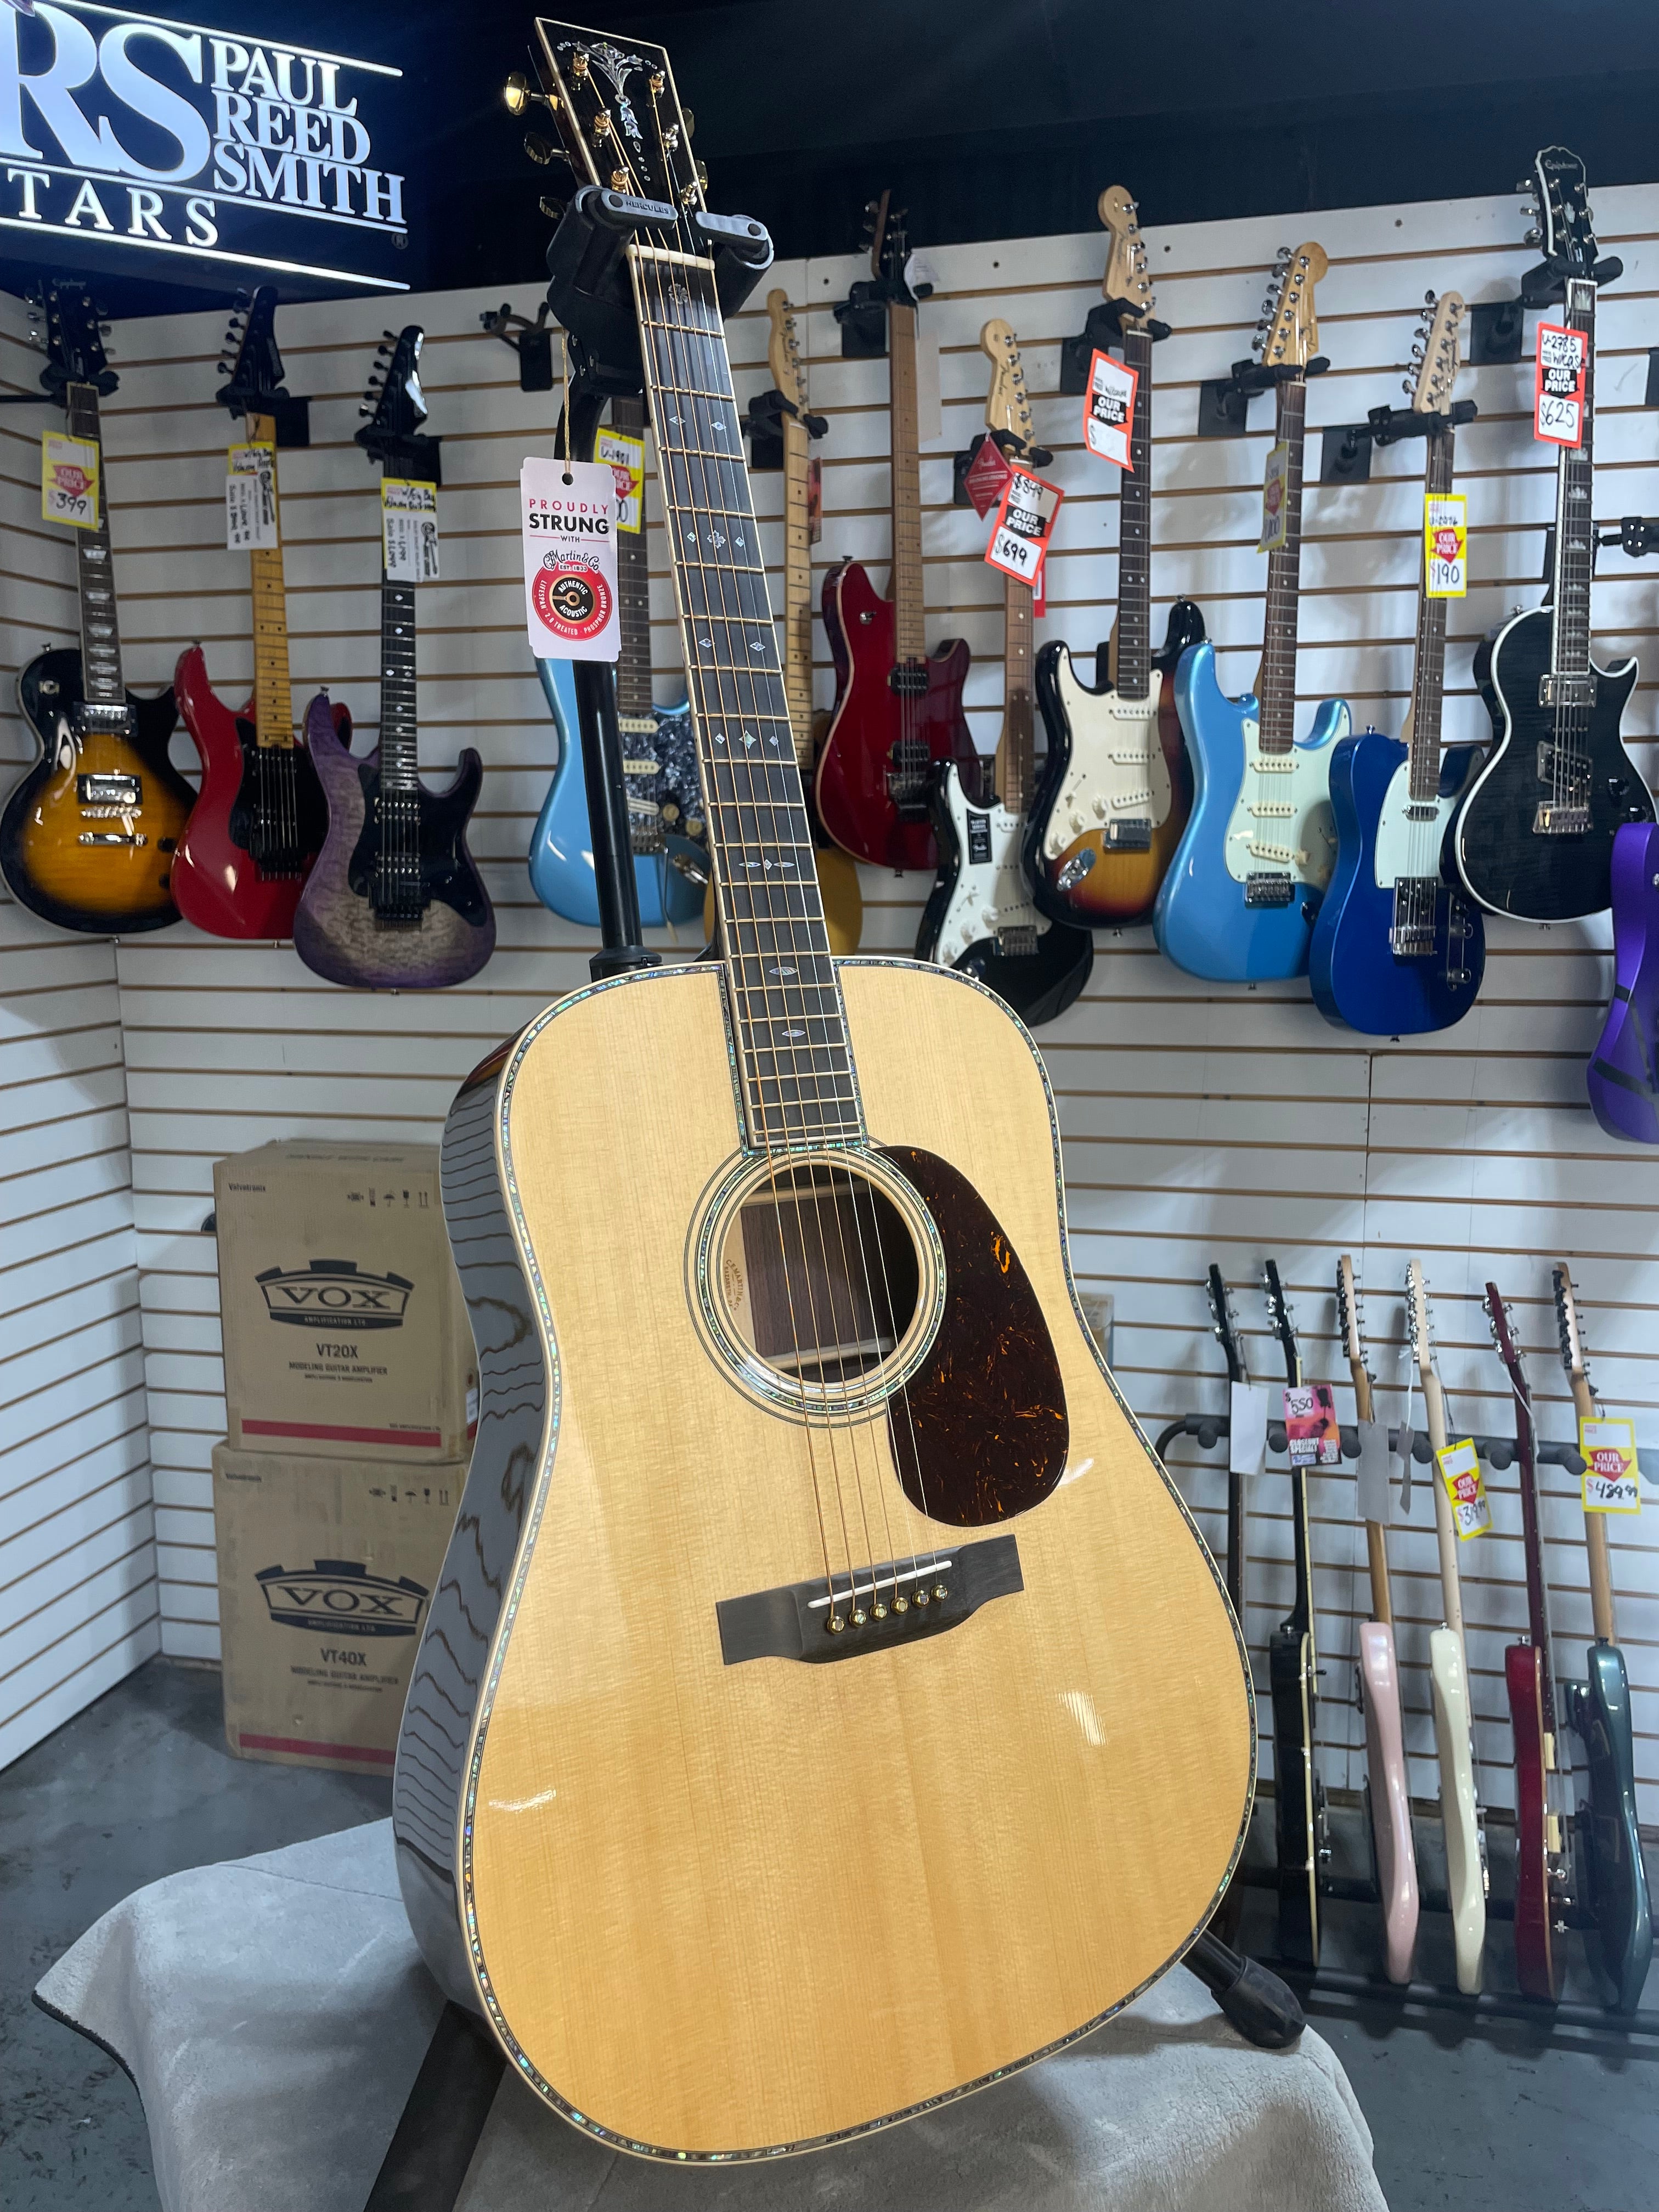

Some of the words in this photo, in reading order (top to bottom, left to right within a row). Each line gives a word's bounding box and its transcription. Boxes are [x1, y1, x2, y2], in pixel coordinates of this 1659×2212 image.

[209, 37, 358, 117] PAUL
[211, 88, 371, 165] REED
[213, 141, 408, 225] SMITH
[8, 168, 219, 247] TARS
[626, 200, 670, 215] HERCULES
[1548, 369, 1571, 381] OUR
[1544, 380, 1576, 392] PRICE
[1098, 396, 1121, 411] OUR
[1093, 405, 1125, 423] PRICE
[1539, 400, 1575, 428] $625
[61, 468, 82, 479] OUR
[529, 498, 608, 514] PROUDLY
[529, 513, 610, 534] STRUNG
[1012, 506, 1039, 526] OUR
[1006, 516, 1043, 537] PRICE
[561, 535, 580, 543] WITH
[1438, 532, 1456, 543] OUR
[994, 533, 1028, 567] $699
[1436, 543, 1459, 555] PRICE
[558, 580, 588, 595] AUTHENTIC
[538, 580, 547, 610] LIFESPAN
[554, 621, 578, 635] TREATED
[583, 610, 606, 634] PHOSPHOR
[596, 584, 607, 609] BRONZE
[559, 605, 588, 618] ACOUSTIC
[275, 1285, 391, 1310] VOX
[316, 1342, 358, 1359] VT20X
[352, 1365, 388, 1375] AMPLIFIER
[1596, 1452, 1620, 1463] OUR
[1594, 1462, 1624, 1473] PRICE
[1457, 1476, 1474, 1489] OUR
[1457, 1485, 1477, 1499] PRICE
[277, 1585, 403, 1616] VOX
[320, 1647, 367, 1667] VT40X
